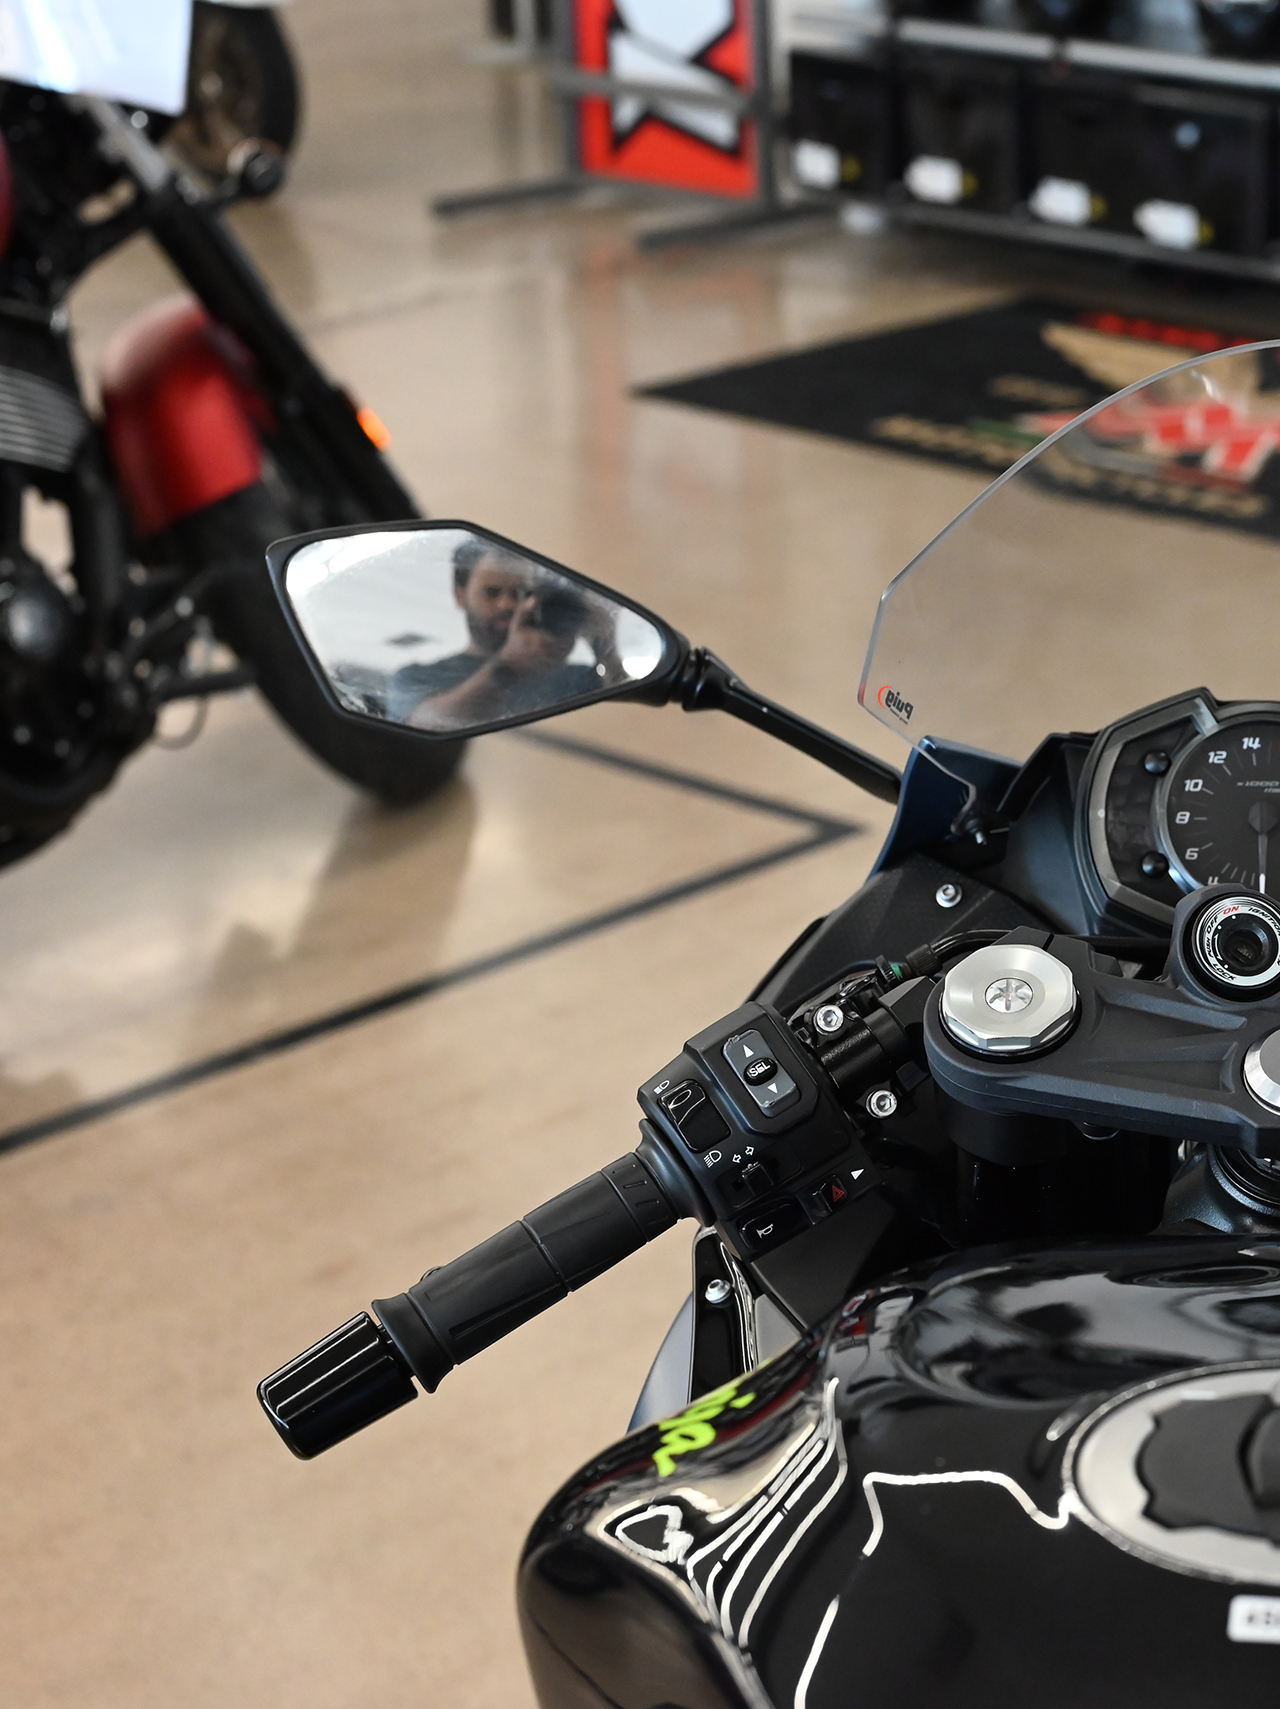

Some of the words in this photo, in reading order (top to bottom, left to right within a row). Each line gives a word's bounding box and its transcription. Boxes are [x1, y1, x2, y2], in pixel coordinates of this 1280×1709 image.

[1242, 737, 1261, 750] 14
[1208, 751, 1227, 764] 12
[1184, 779, 1203, 792] 10
[1175, 811, 1191, 824] 8
[1185, 848, 1199, 860] 6
[1223, 905, 1240, 915] ON
[1206, 915, 1218, 934] OFF
[1206, 937, 1214, 958] PUSH
[1213, 963, 1236, 981] LOCK
[748, 1061, 771, 1077] SEL
